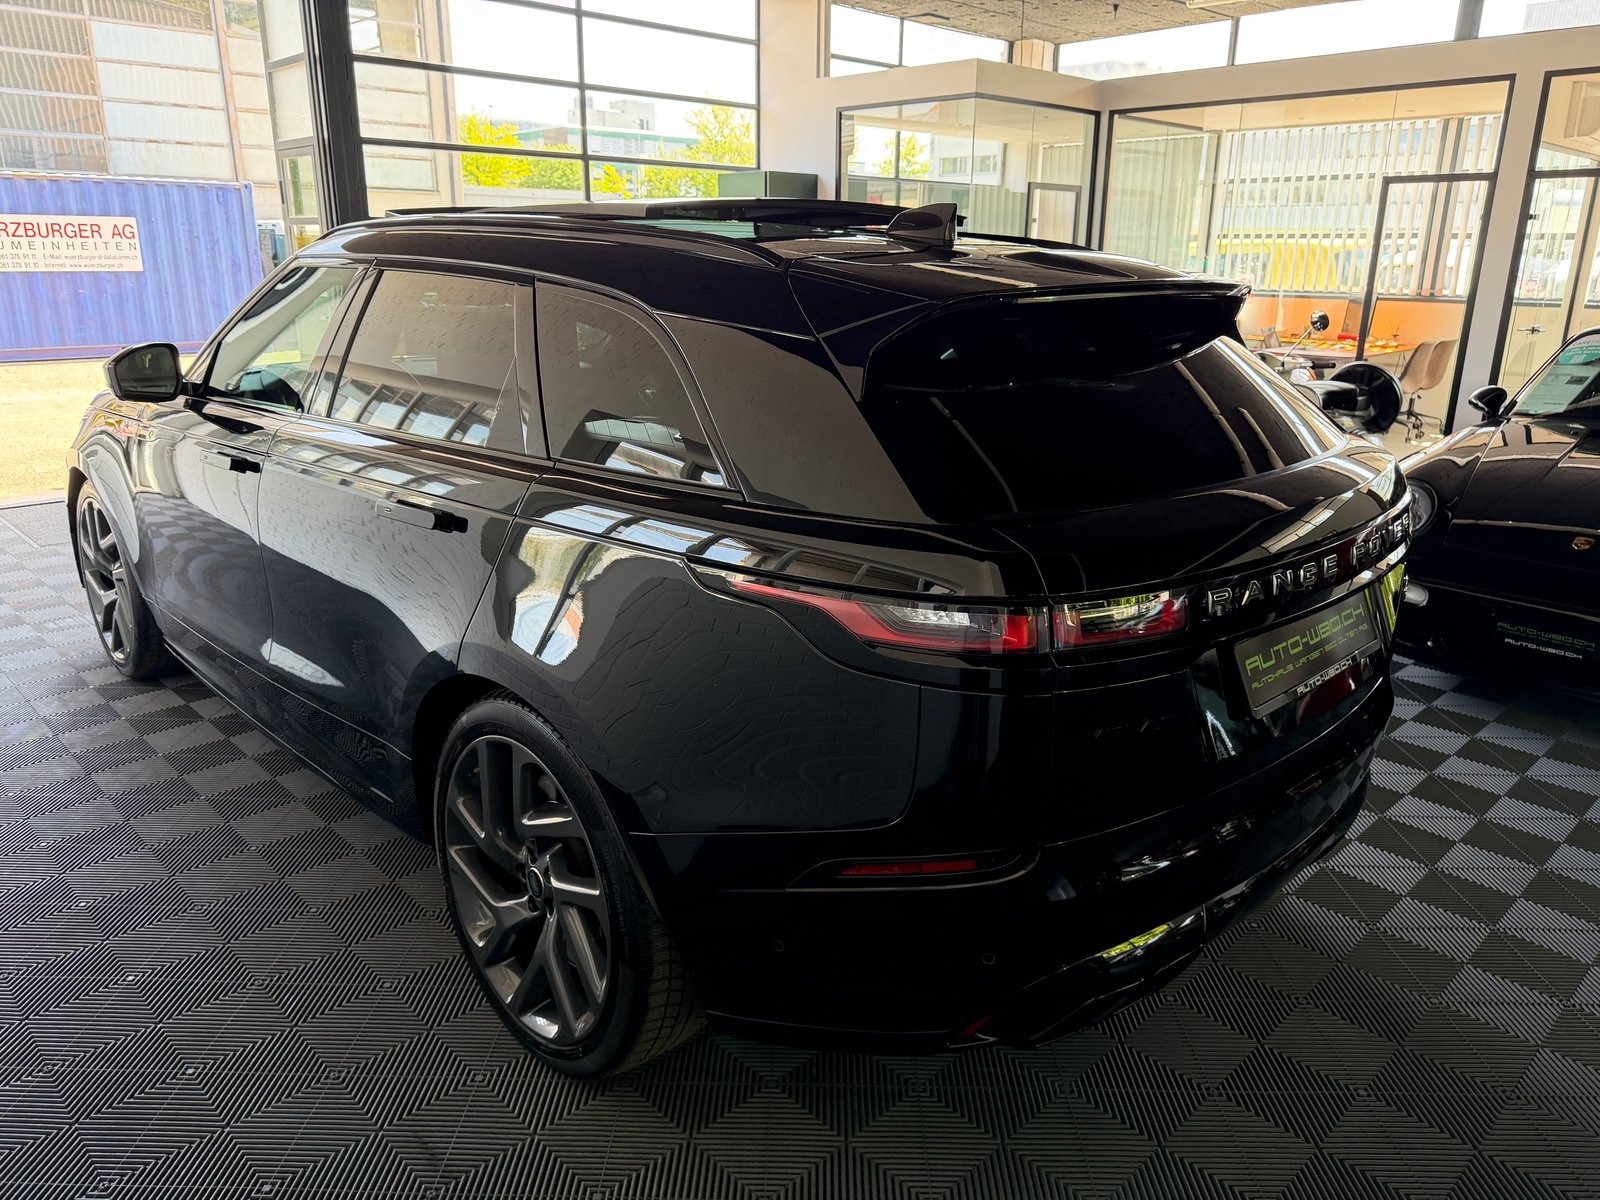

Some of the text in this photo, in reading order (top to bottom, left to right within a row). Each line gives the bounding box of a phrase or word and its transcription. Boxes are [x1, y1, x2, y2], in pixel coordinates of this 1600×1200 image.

[111, 224, 136, 239] AG
[1207, 553, 1339, 616] RANGE
[1251, 663, 1294, 690] AUTOHAUS
